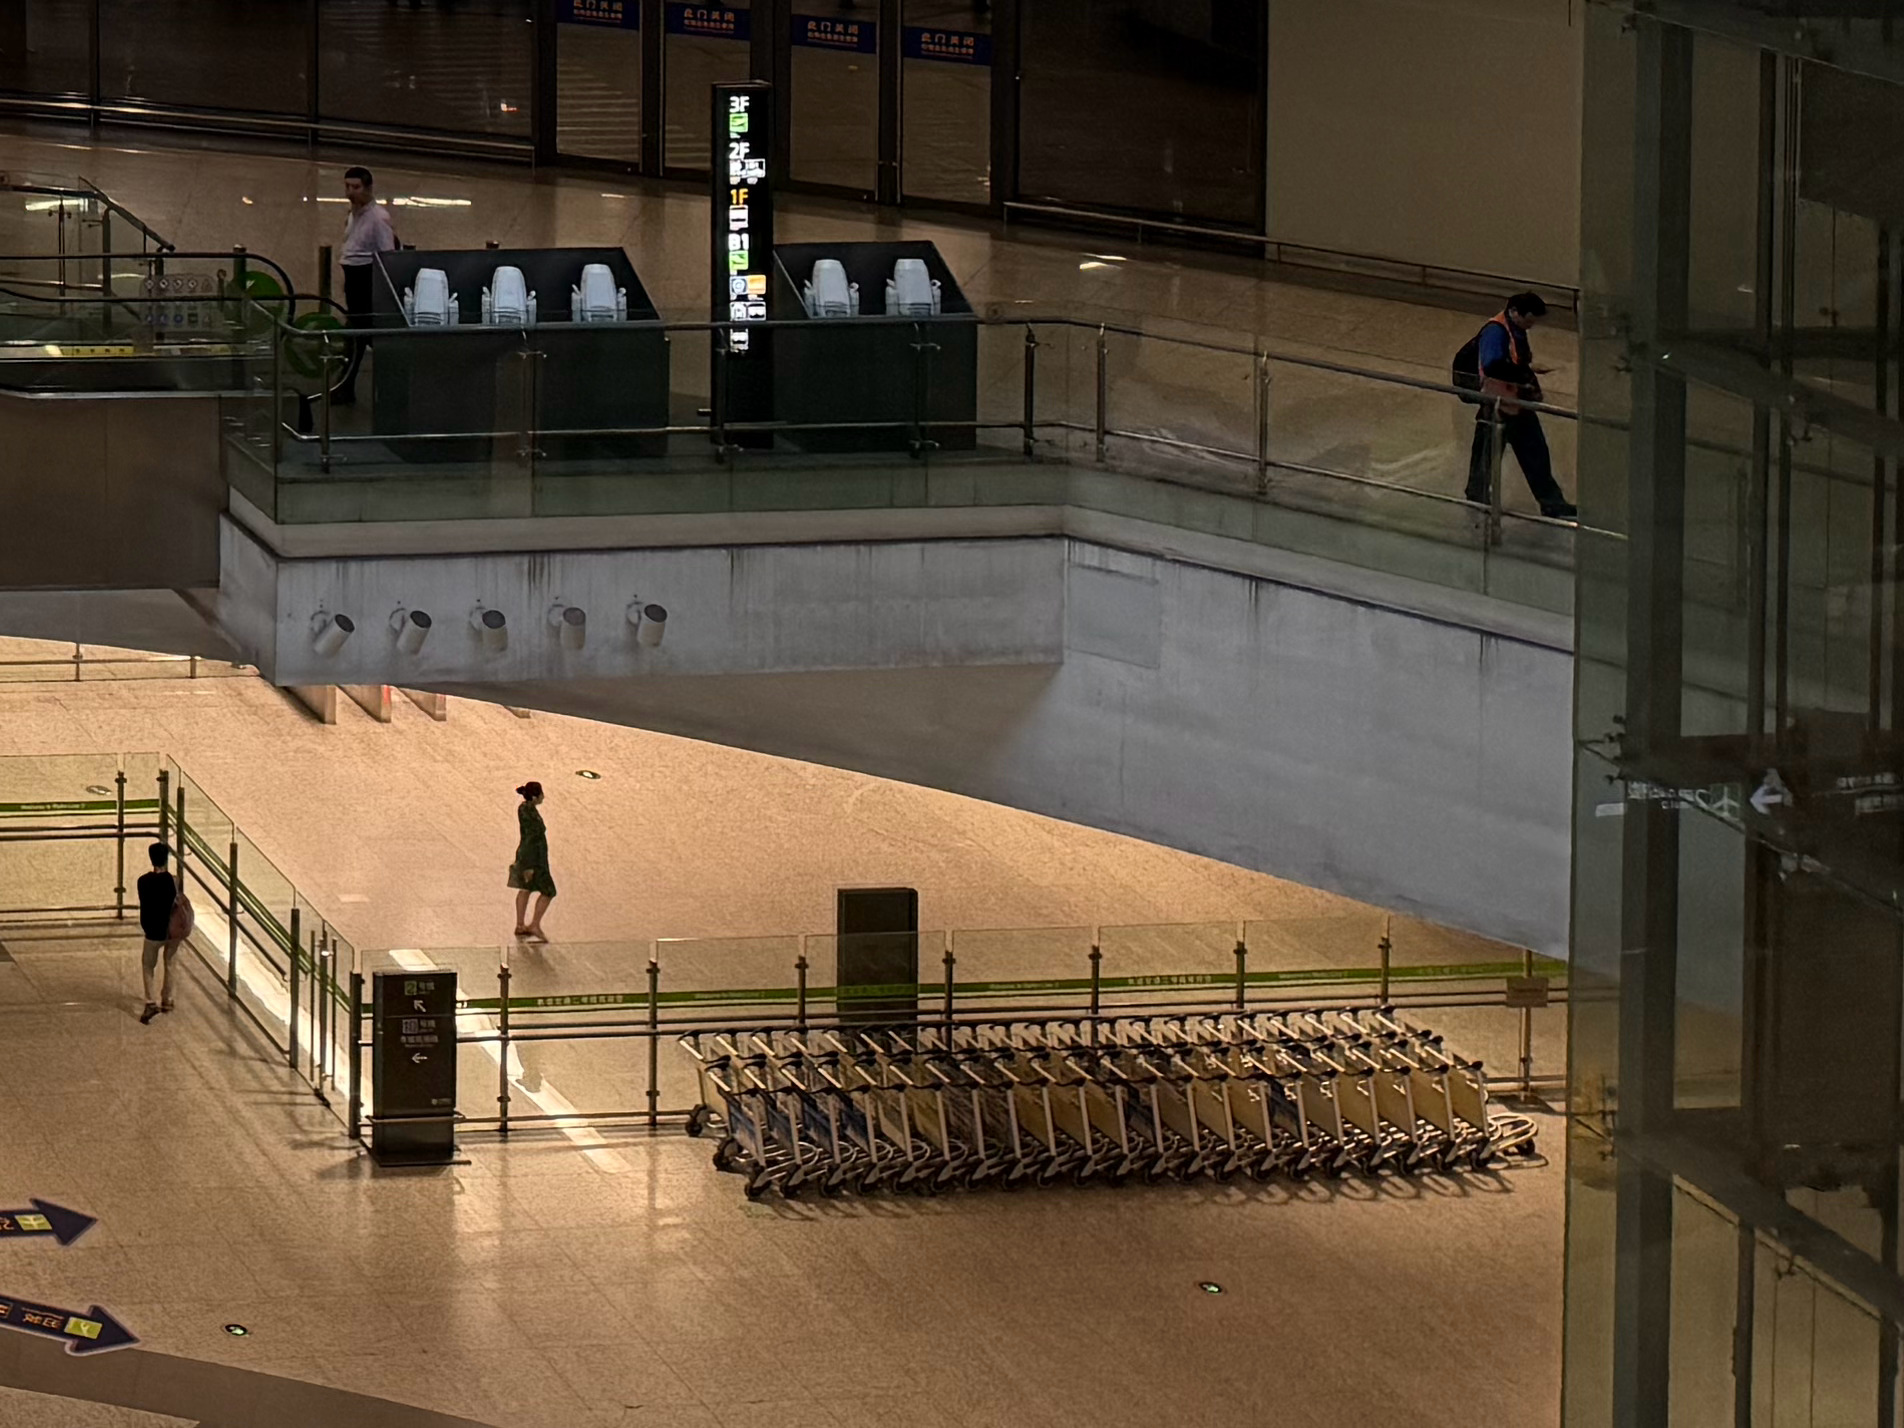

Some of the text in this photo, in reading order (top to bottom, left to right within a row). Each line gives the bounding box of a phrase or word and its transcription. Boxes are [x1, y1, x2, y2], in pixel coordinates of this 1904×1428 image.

[729, 96, 750, 112] 3F
[728, 142, 750, 159] 2F
[730, 189, 749, 205] 1F
